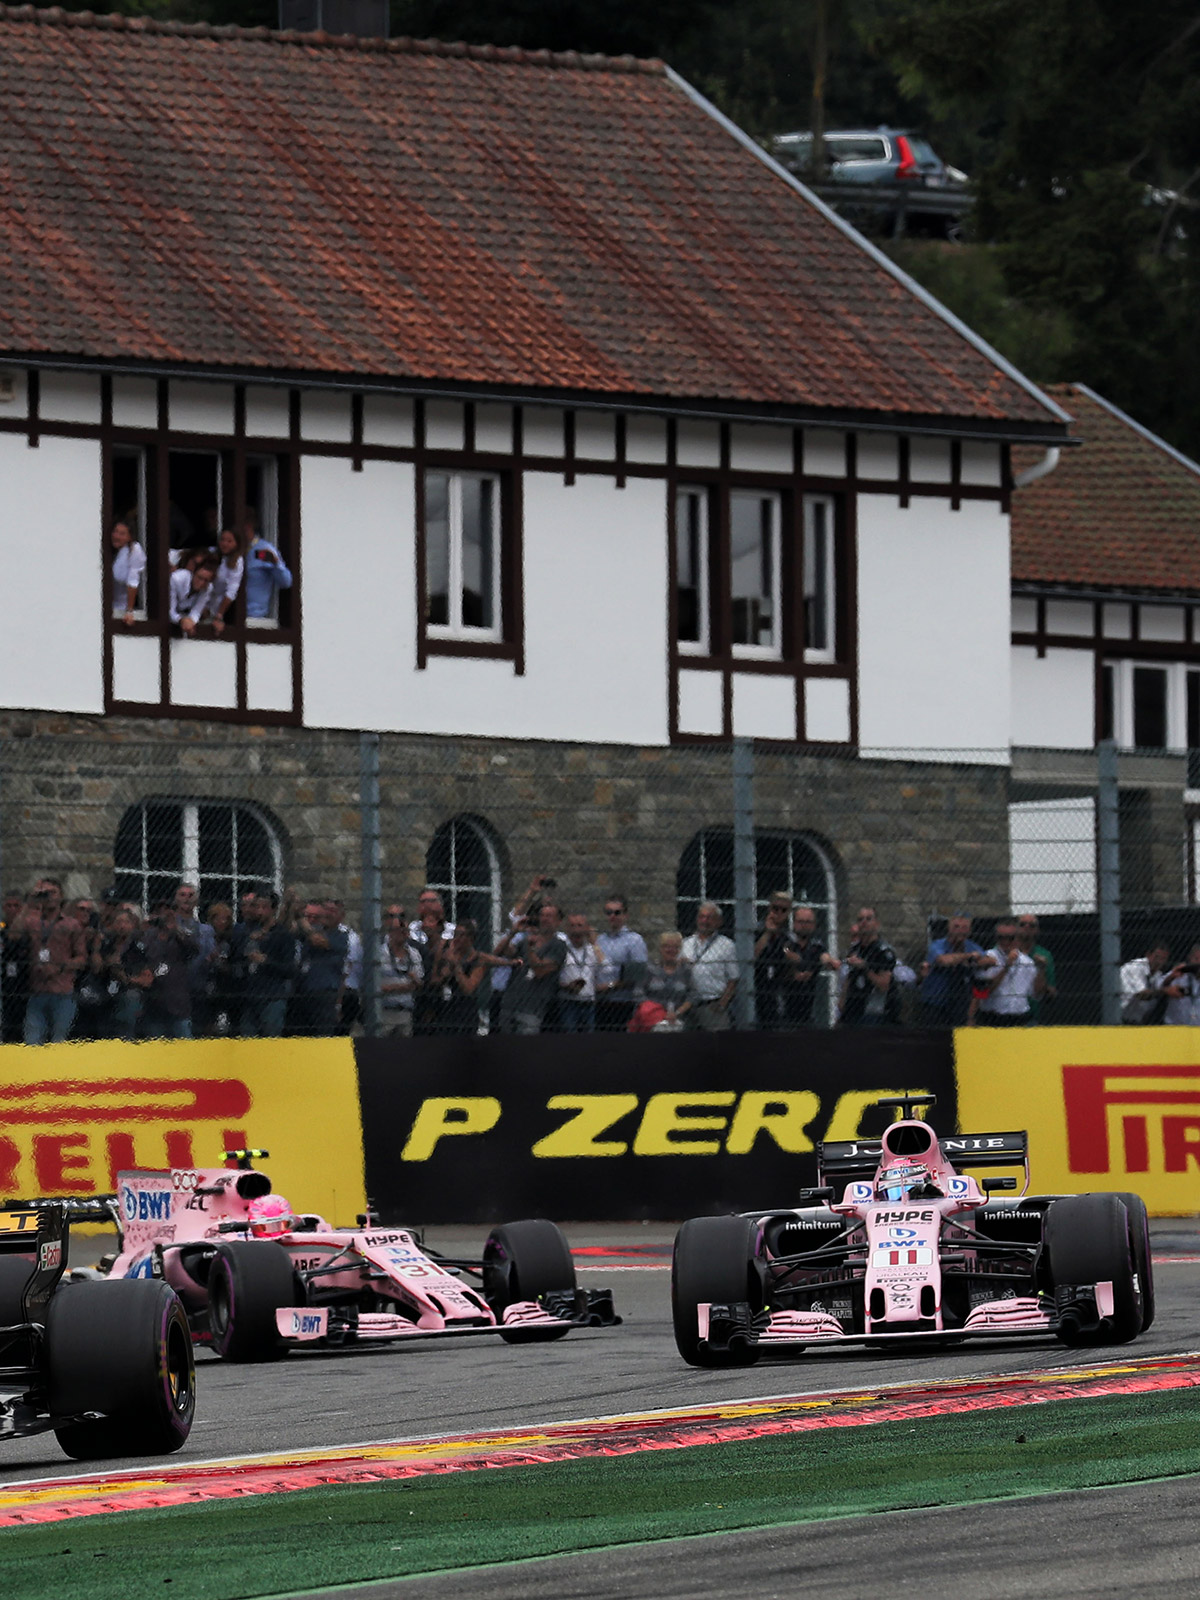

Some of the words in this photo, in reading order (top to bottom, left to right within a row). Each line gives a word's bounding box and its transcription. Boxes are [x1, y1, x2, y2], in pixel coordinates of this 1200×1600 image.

[400, 1096, 501, 1161] P
[532, 1088, 930, 1157] ZERO
[138, 1191, 171, 1220] BWT
[875, 1211, 933, 1223] HYPE
[984, 1209, 1041, 1220] infinitum
[785, 1220, 841, 1230] infinitum
[365, 1234, 409, 1246] HYPE
[878, 1240, 927, 1248] BWT
[889, 1250, 917, 1265] 11
[400, 1263, 445, 1277] 31
[301, 1316, 321, 1333] BWT
